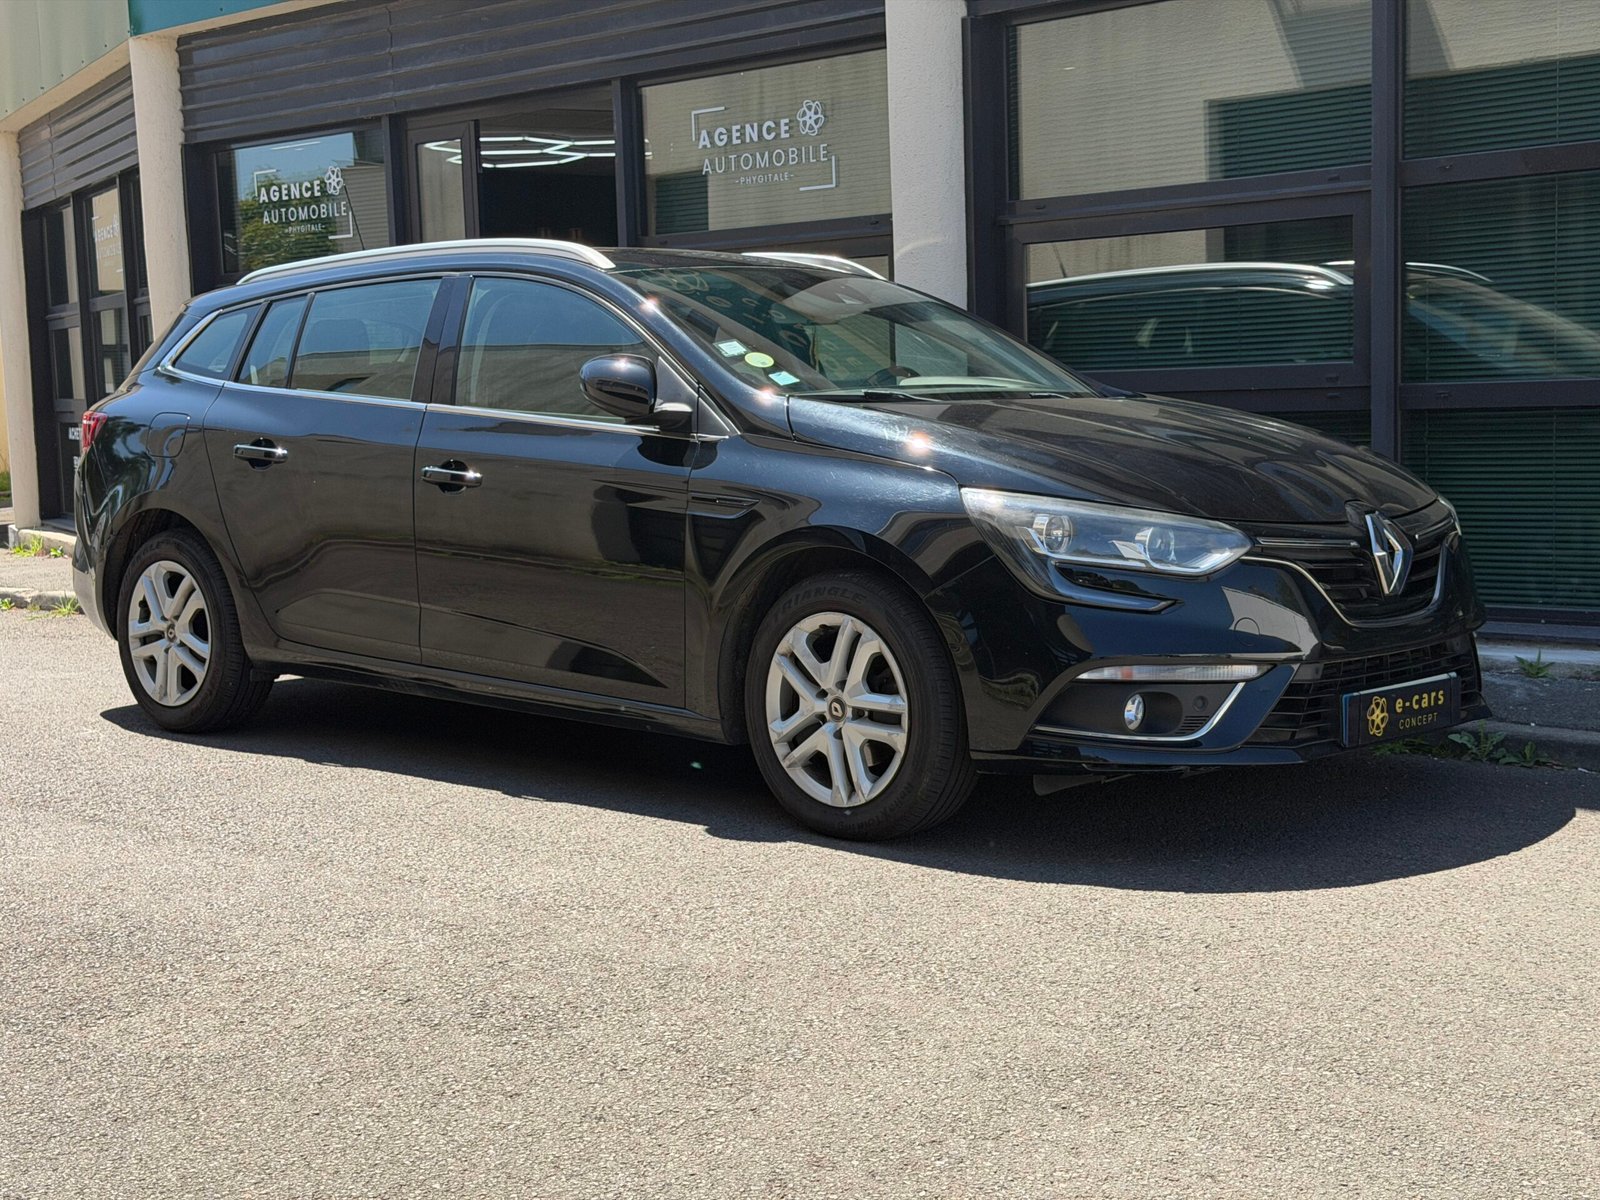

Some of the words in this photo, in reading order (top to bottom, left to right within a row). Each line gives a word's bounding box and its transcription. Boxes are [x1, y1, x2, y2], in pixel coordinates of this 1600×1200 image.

[698, 118, 790, 149] AGENCE
[702, 143, 828, 175] AUTOMOBILE
[259, 180, 321, 203] AGENCE
[263, 201, 347, 225] AUTOMOBILE
[1395, 690, 1445, 713] e-cars
[1399, 712, 1439, 730] CONCEPT
